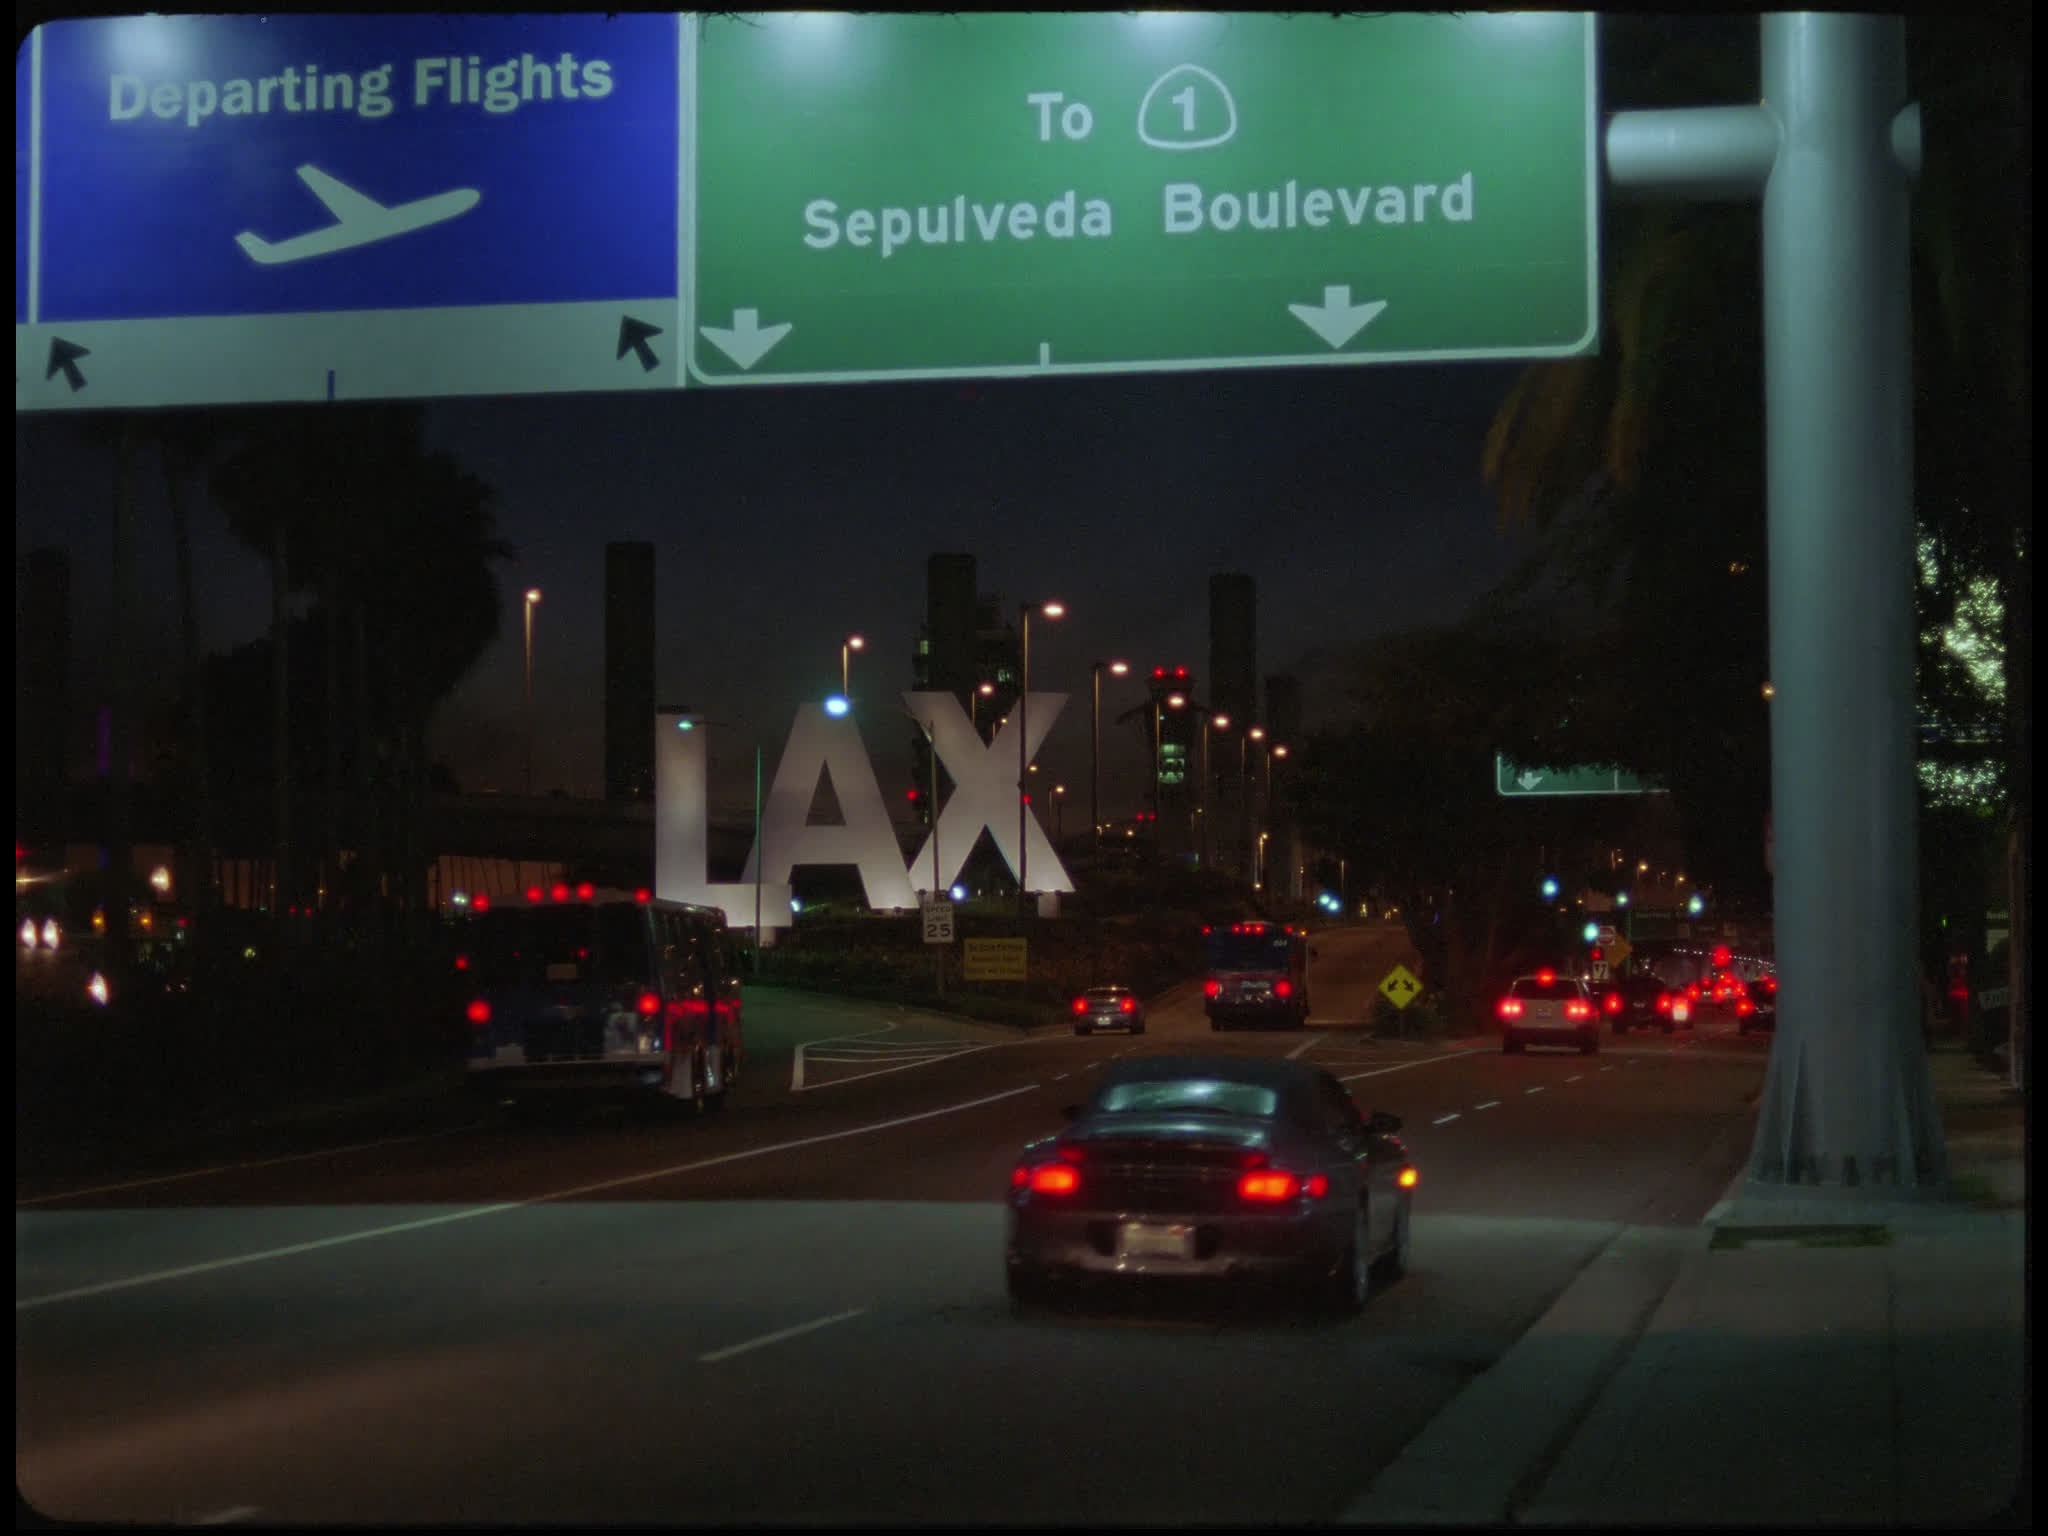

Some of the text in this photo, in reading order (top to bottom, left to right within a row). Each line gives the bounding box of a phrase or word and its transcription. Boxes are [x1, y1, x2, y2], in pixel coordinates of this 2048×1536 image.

[108, 52, 615, 127] Departing Flights
[1027, 86, 1196, 141] To 1
[803, 171, 1473, 258] Sepulveda Boulevard
[654, 690, 1076, 928] LAX
[927, 923, 951, 937] 25
